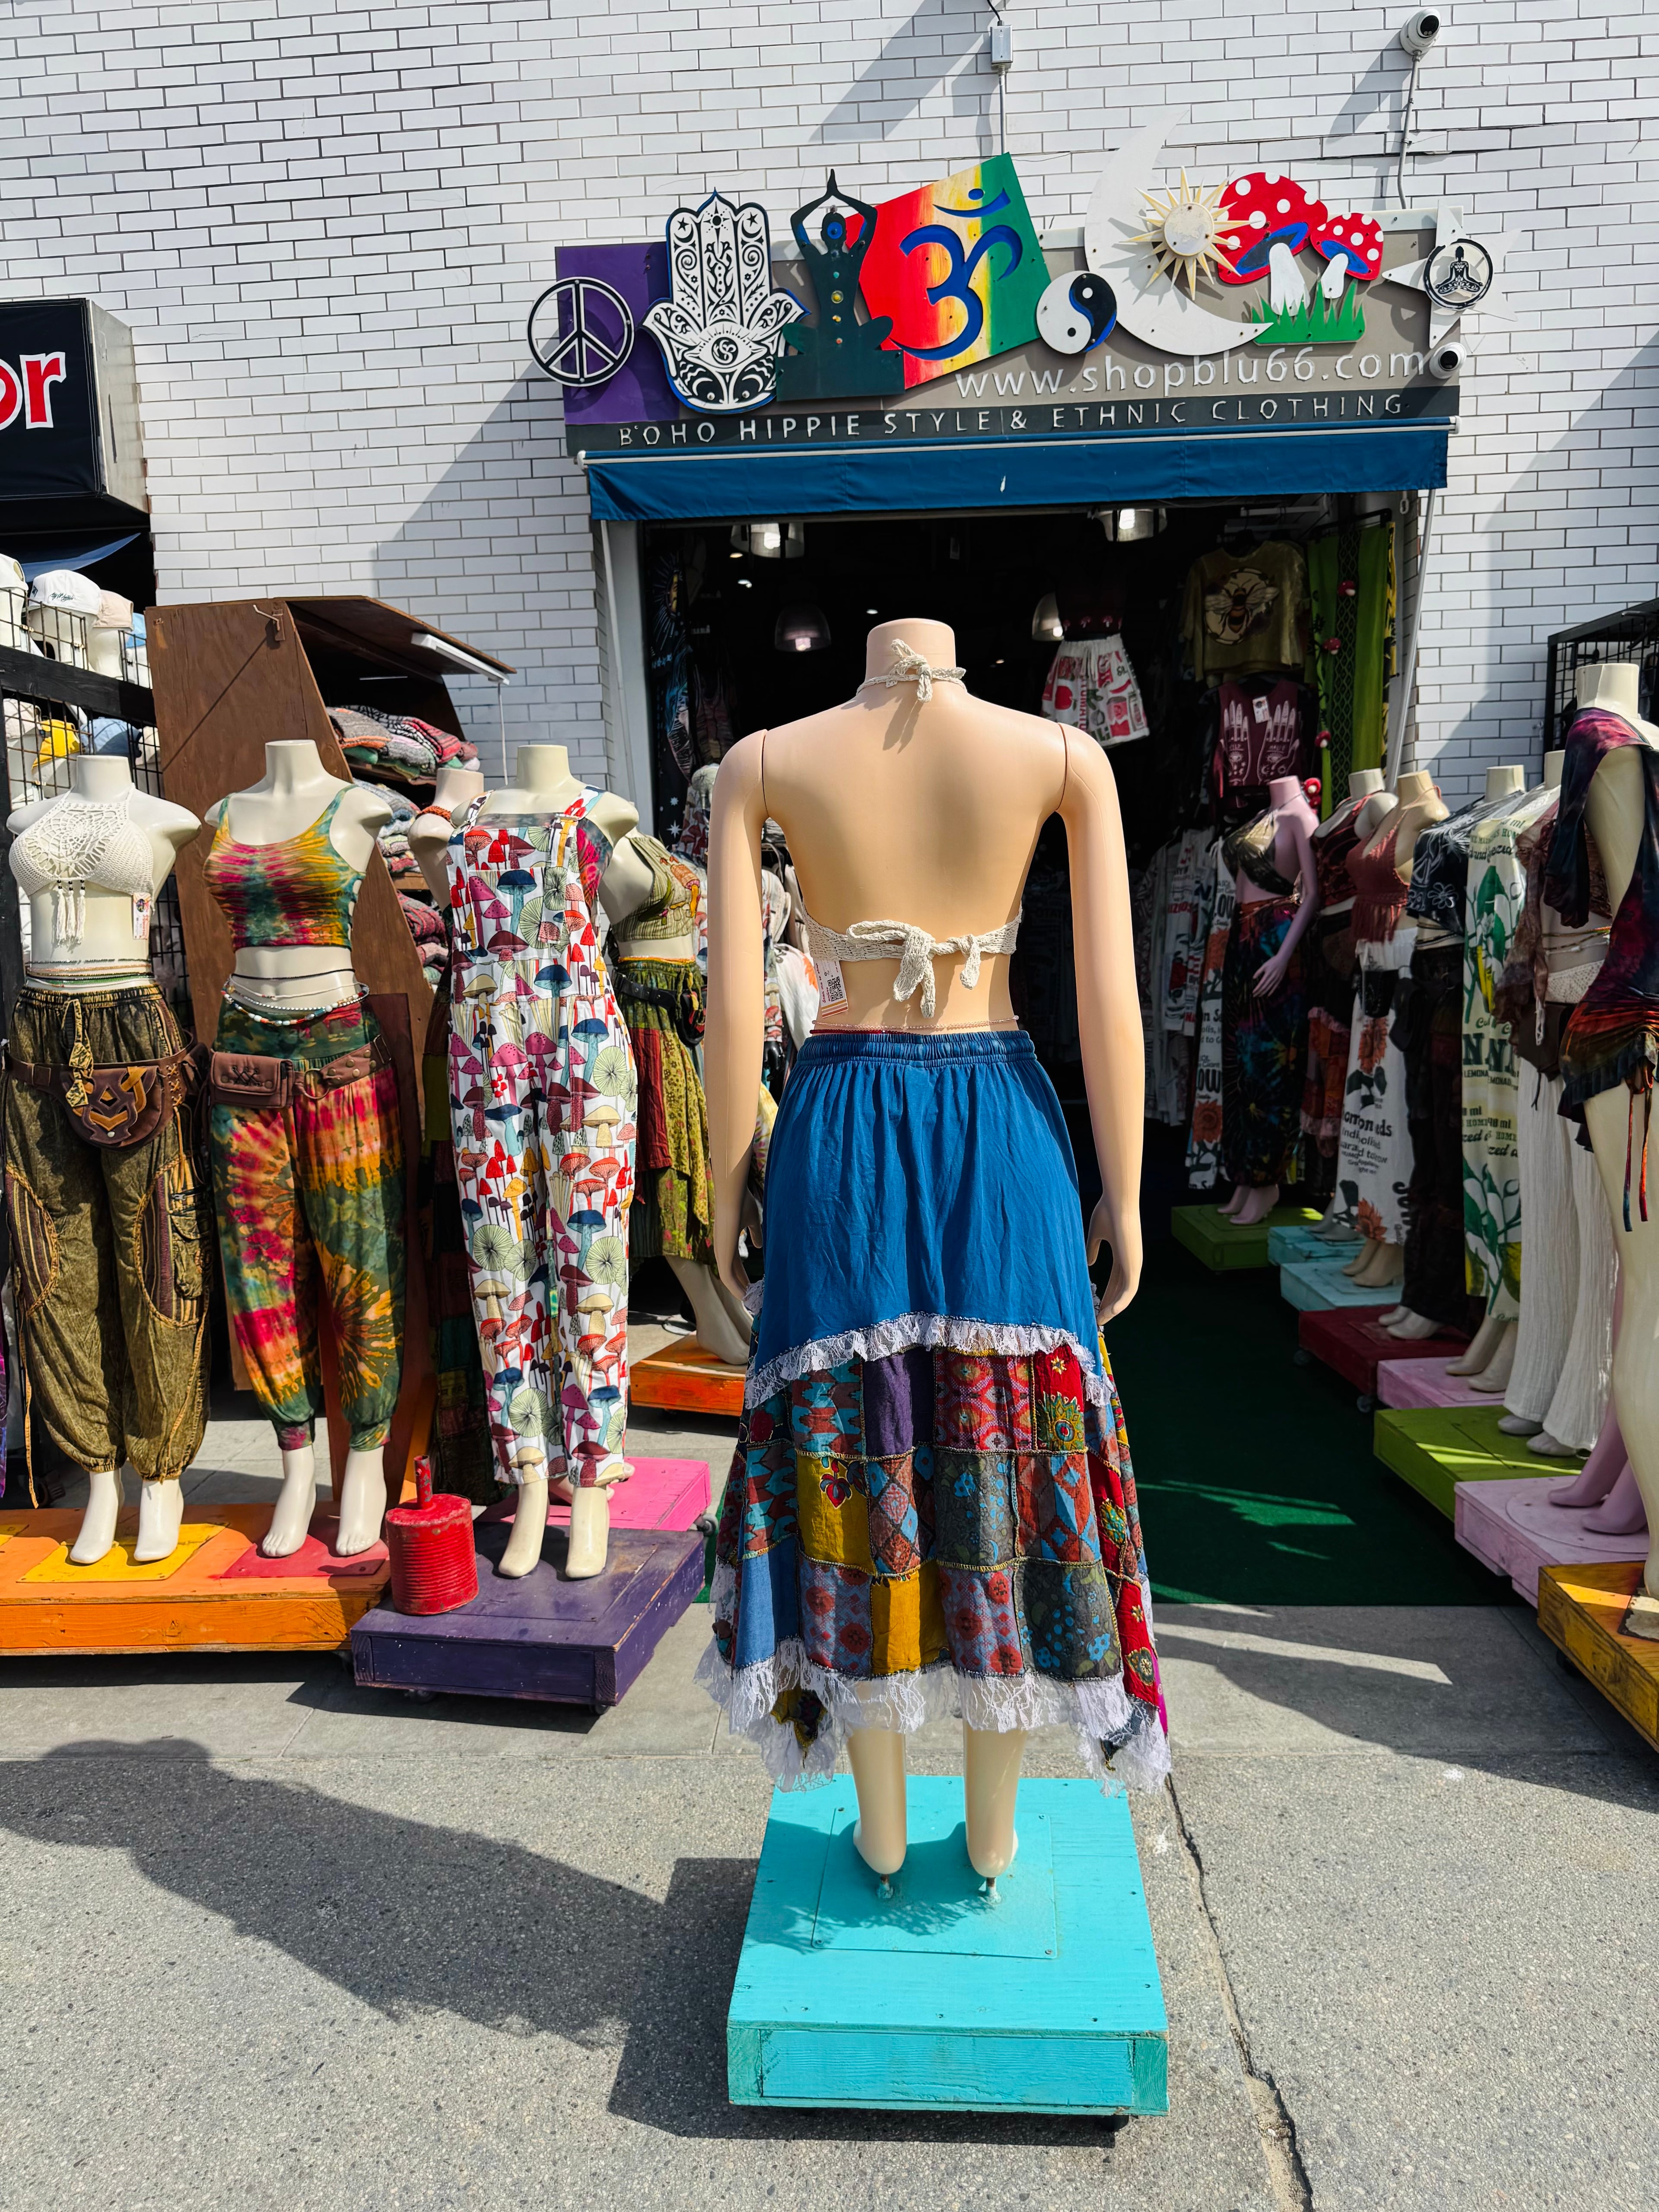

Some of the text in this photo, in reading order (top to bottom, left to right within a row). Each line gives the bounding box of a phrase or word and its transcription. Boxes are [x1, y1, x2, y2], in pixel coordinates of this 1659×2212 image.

[955, 346, 1424, 398] www.shopblu66.com
[620, 394, 1401, 446] BOHO HIPPIE STYLE & ETHNIC CLOTHING
